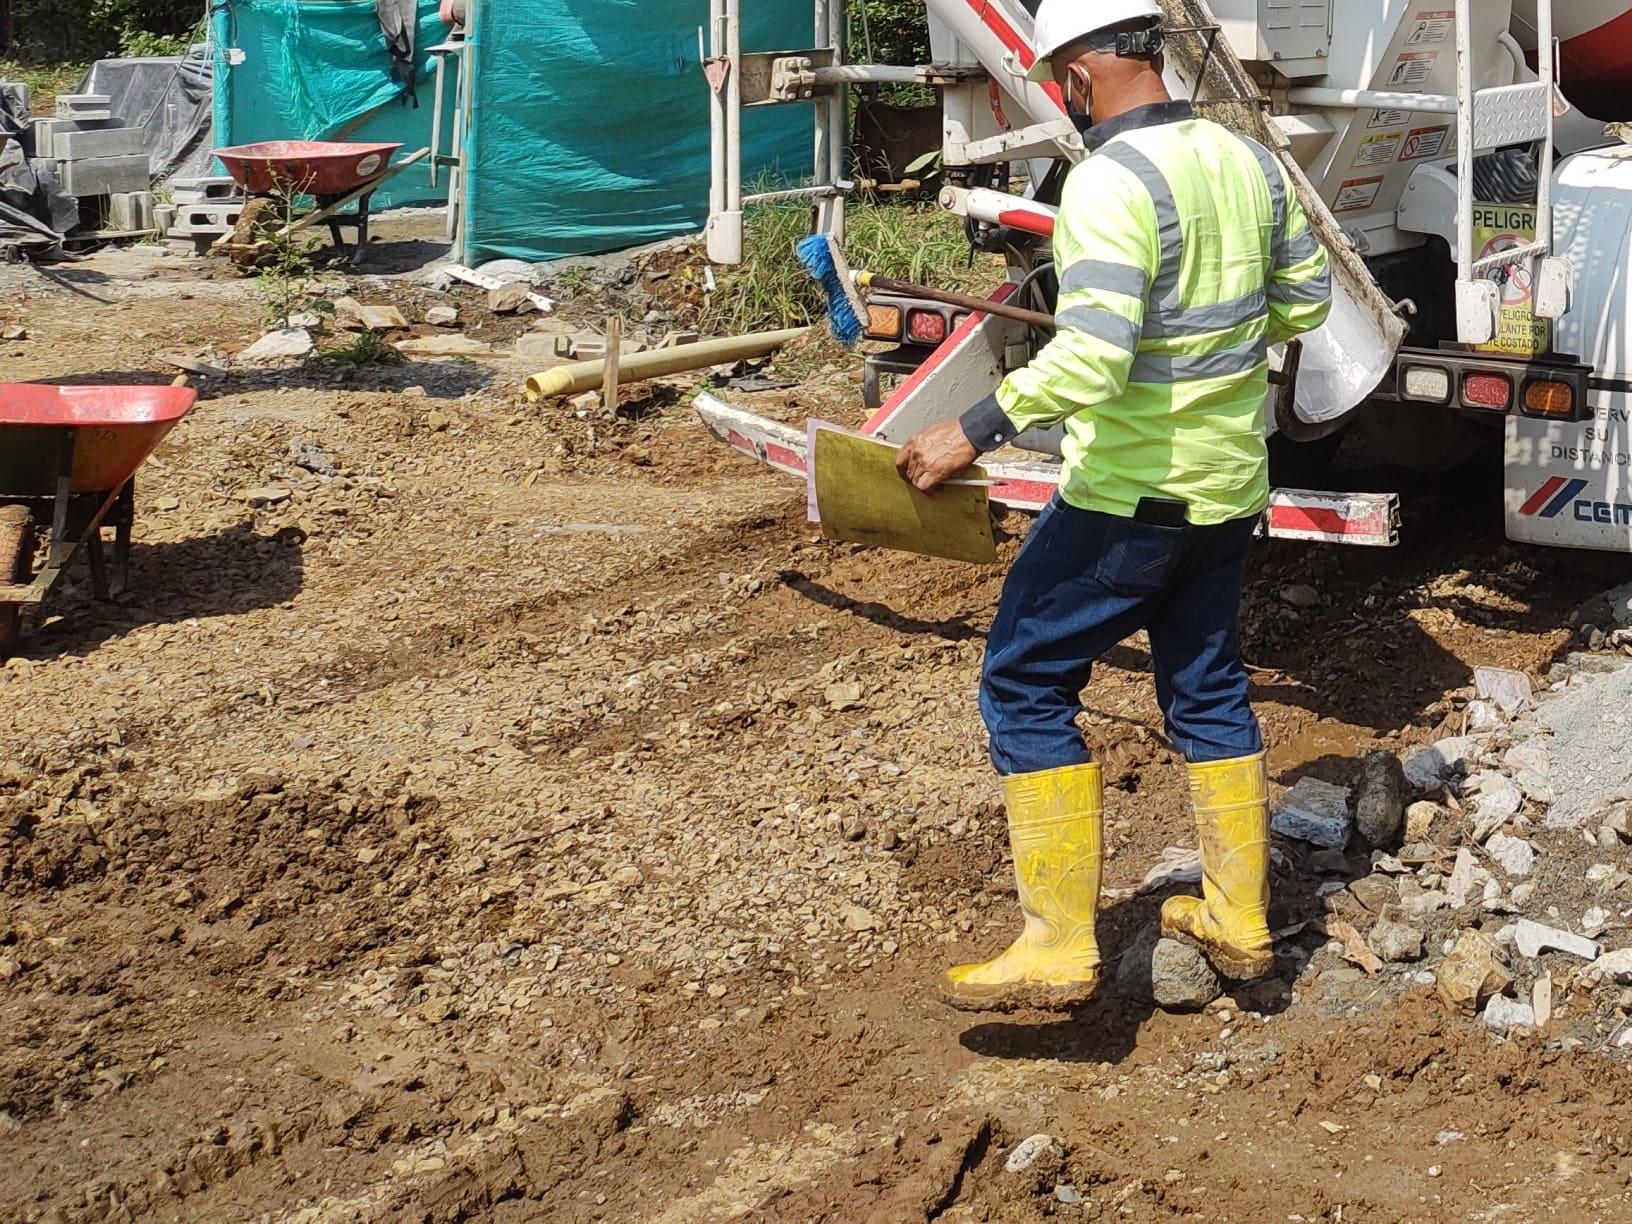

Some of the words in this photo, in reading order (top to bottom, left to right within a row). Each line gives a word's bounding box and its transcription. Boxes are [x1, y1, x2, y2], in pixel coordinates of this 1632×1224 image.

[1473, 210, 1536, 230] PELIGR
[1500, 309, 1544, 322] ELIGROSA
[1500, 324, 1527, 335] LANTE
[1529, 325, 1546, 337] POR
[1501, 337, 1539, 350] COSTADO
[1585, 427, 1609, 442] SU
